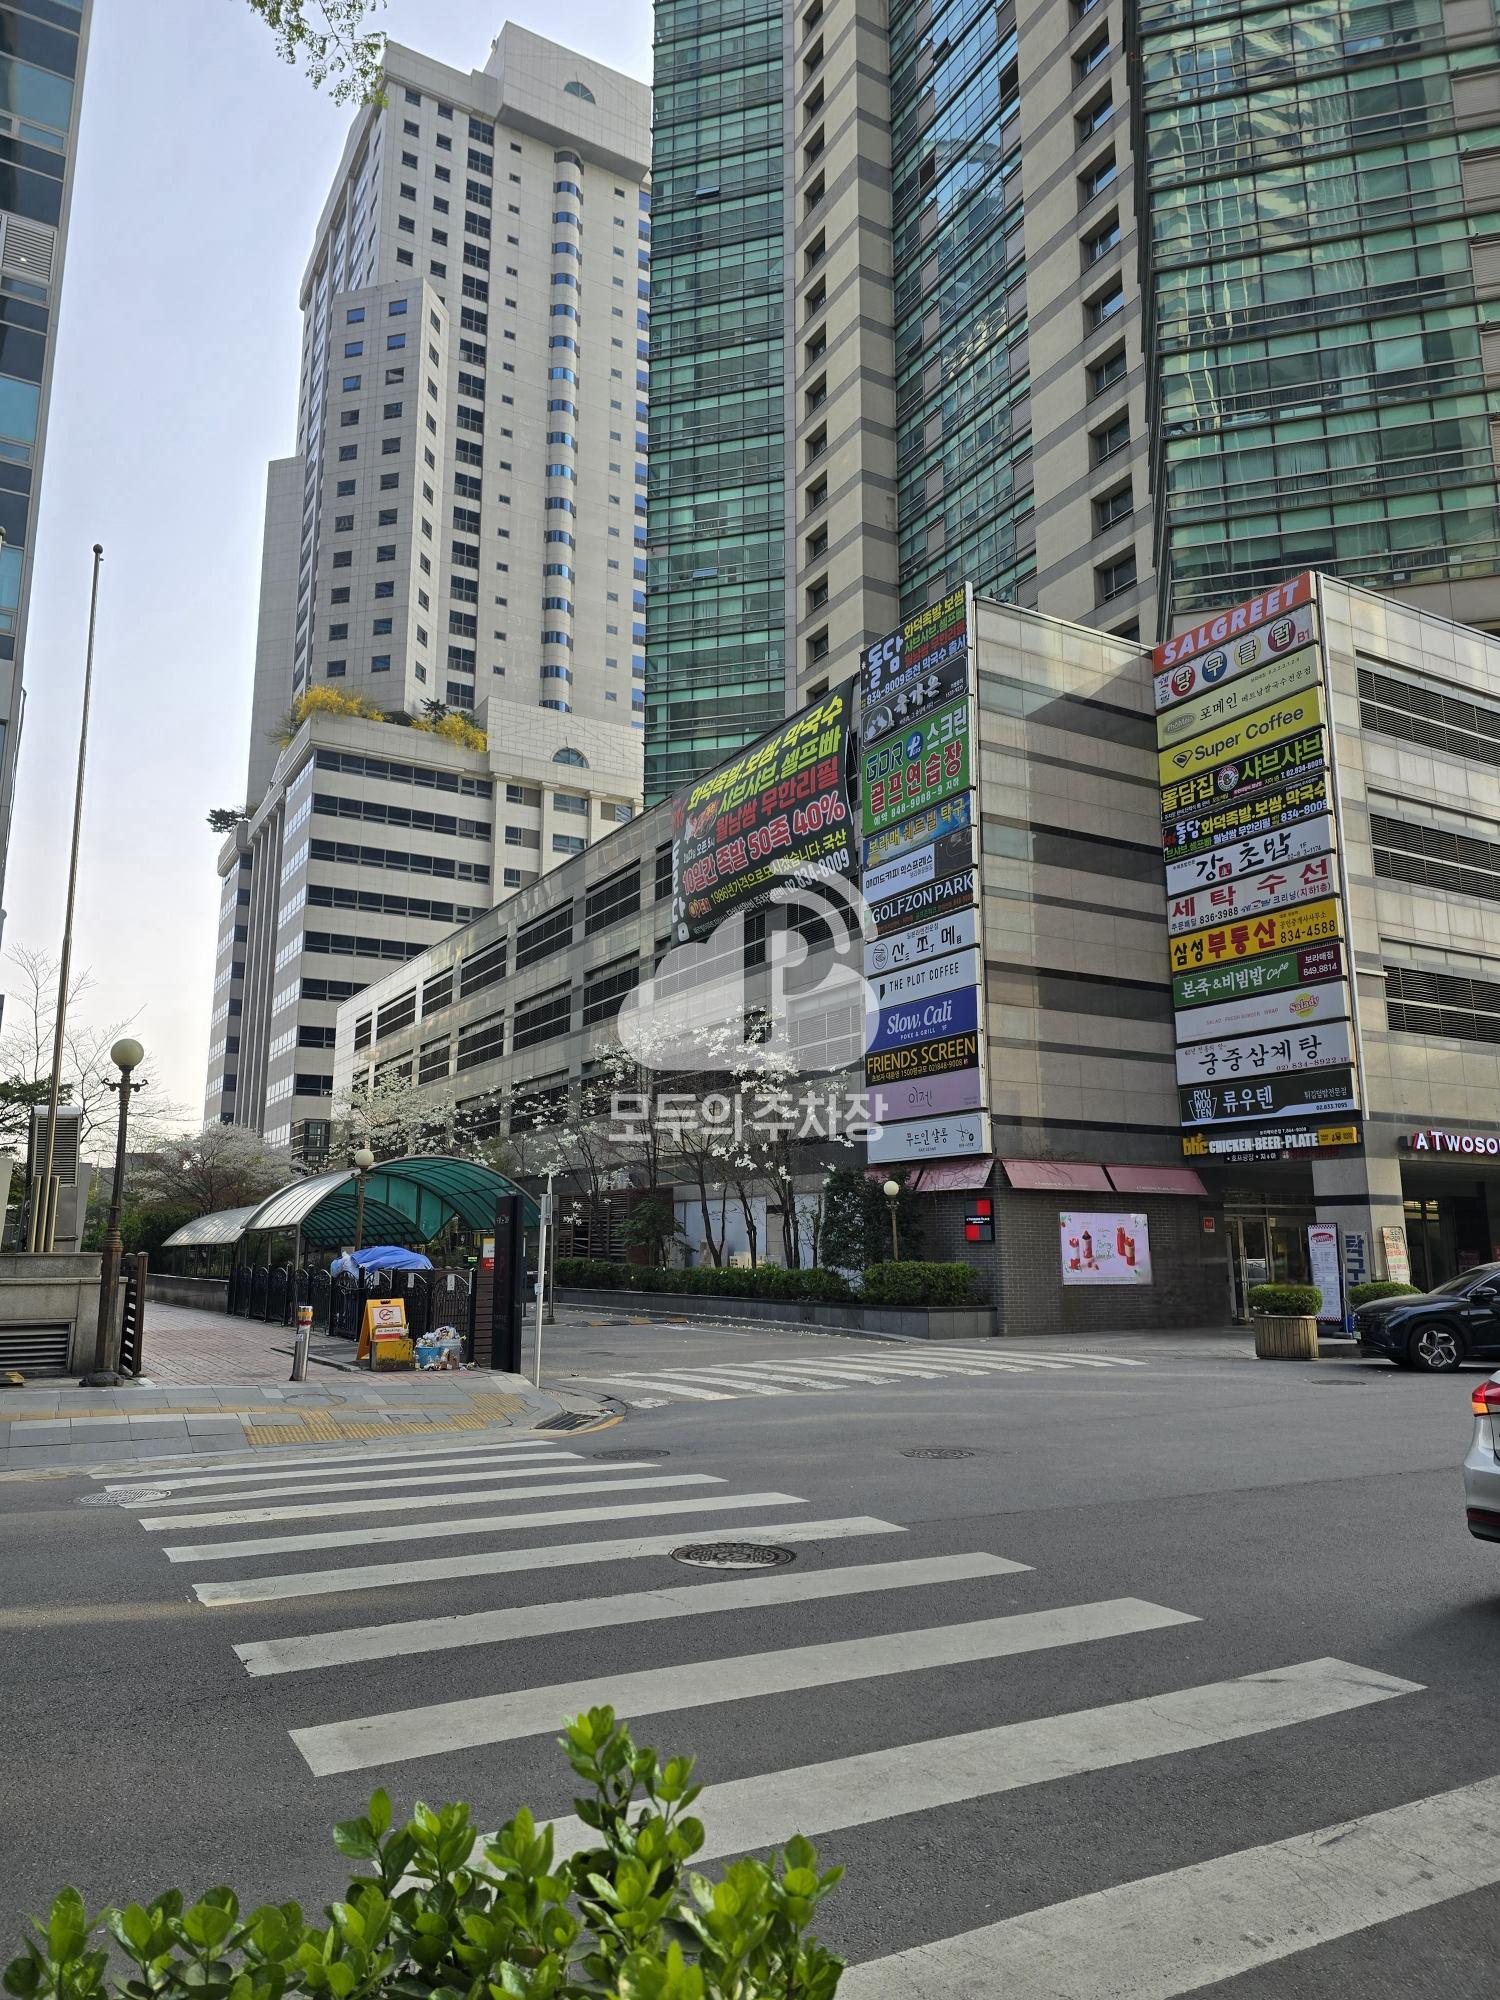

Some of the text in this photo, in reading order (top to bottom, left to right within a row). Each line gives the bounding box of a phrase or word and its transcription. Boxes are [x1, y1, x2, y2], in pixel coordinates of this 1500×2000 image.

[1163, 580, 1299, 664] SALGREET
[868, 635, 903, 689] 돌담
[1176, 621, 1310, 691] 당구클럽 B1
[867, 673, 905, 705] 834-8009
[922, 647, 947, 670] 막국수
[1241, 665, 1312, 703] 베트남쌀국수전문점
[782, 695, 843, 748] 막국수
[1200, 692, 1238, 720] 포메인
[926, 704, 967, 751] 스크린
[1195, 708, 1304, 761] Super Coffee
[866, 740, 903, 783] GDR
[871, 739, 962, 815] 골프연습장
[761, 756, 839, 816] 무한리필
[873, 812, 887, 826] 예약
[946, 778, 959, 790] 지하
[1161, 773, 1215, 813] 돌담집
[869, 827, 900, 855] 보라매
[941, 798, 966, 822] 탁구
[1176, 819, 1200, 845] 돌담
[1238, 818, 1271, 836] 무한리필
[1280, 800, 1329, 822] 834-8009
[682, 853, 719, 896] 10일간
[716, 837, 749, 875] 족발
[748, 815, 793, 861] 50족
[793, 790, 846, 835] 40%
[872, 890, 932, 924] GOLFZON
[934, 873, 974, 902] PARK
[1172, 858, 1329, 918] 세탁 수선
[1199, 907, 1239, 926] 836-3988
[1280, 920, 1336, 944] 834-4588
[1174, 919, 1277, 967] 삼성 부동산
[1305, 950, 1334, 964] 보라매점
[889, 962, 959, 992] THE PLOT COFFEE
[1303, 962, 1338, 976] 849.8814
[923, 1000, 952, 1026] Cali
[1289, 994, 1320, 1014] Salady
[900, 1031, 914, 1041] POKE
[920, 1028, 936, 1037] GRILL
[867, 1036, 976, 1074] FRIENDS SCREEN
[1198, 1034, 1322, 1075] 궁중삼계탕
[1292, 1056, 1337, 1069] 834-8922
[1193, 1089, 1211, 1099] RYU
[1193, 1099, 1211, 1109] WOO
[1222, 1084, 1273, 1114] 류우텐
[1194, 1109, 1212, 1118] TEN
[906, 1128, 949, 1147] 무드인 살롱
[1183, 1137, 1210, 1156] bhc
[1415, 1130, 1500, 1154] A TWOSO
